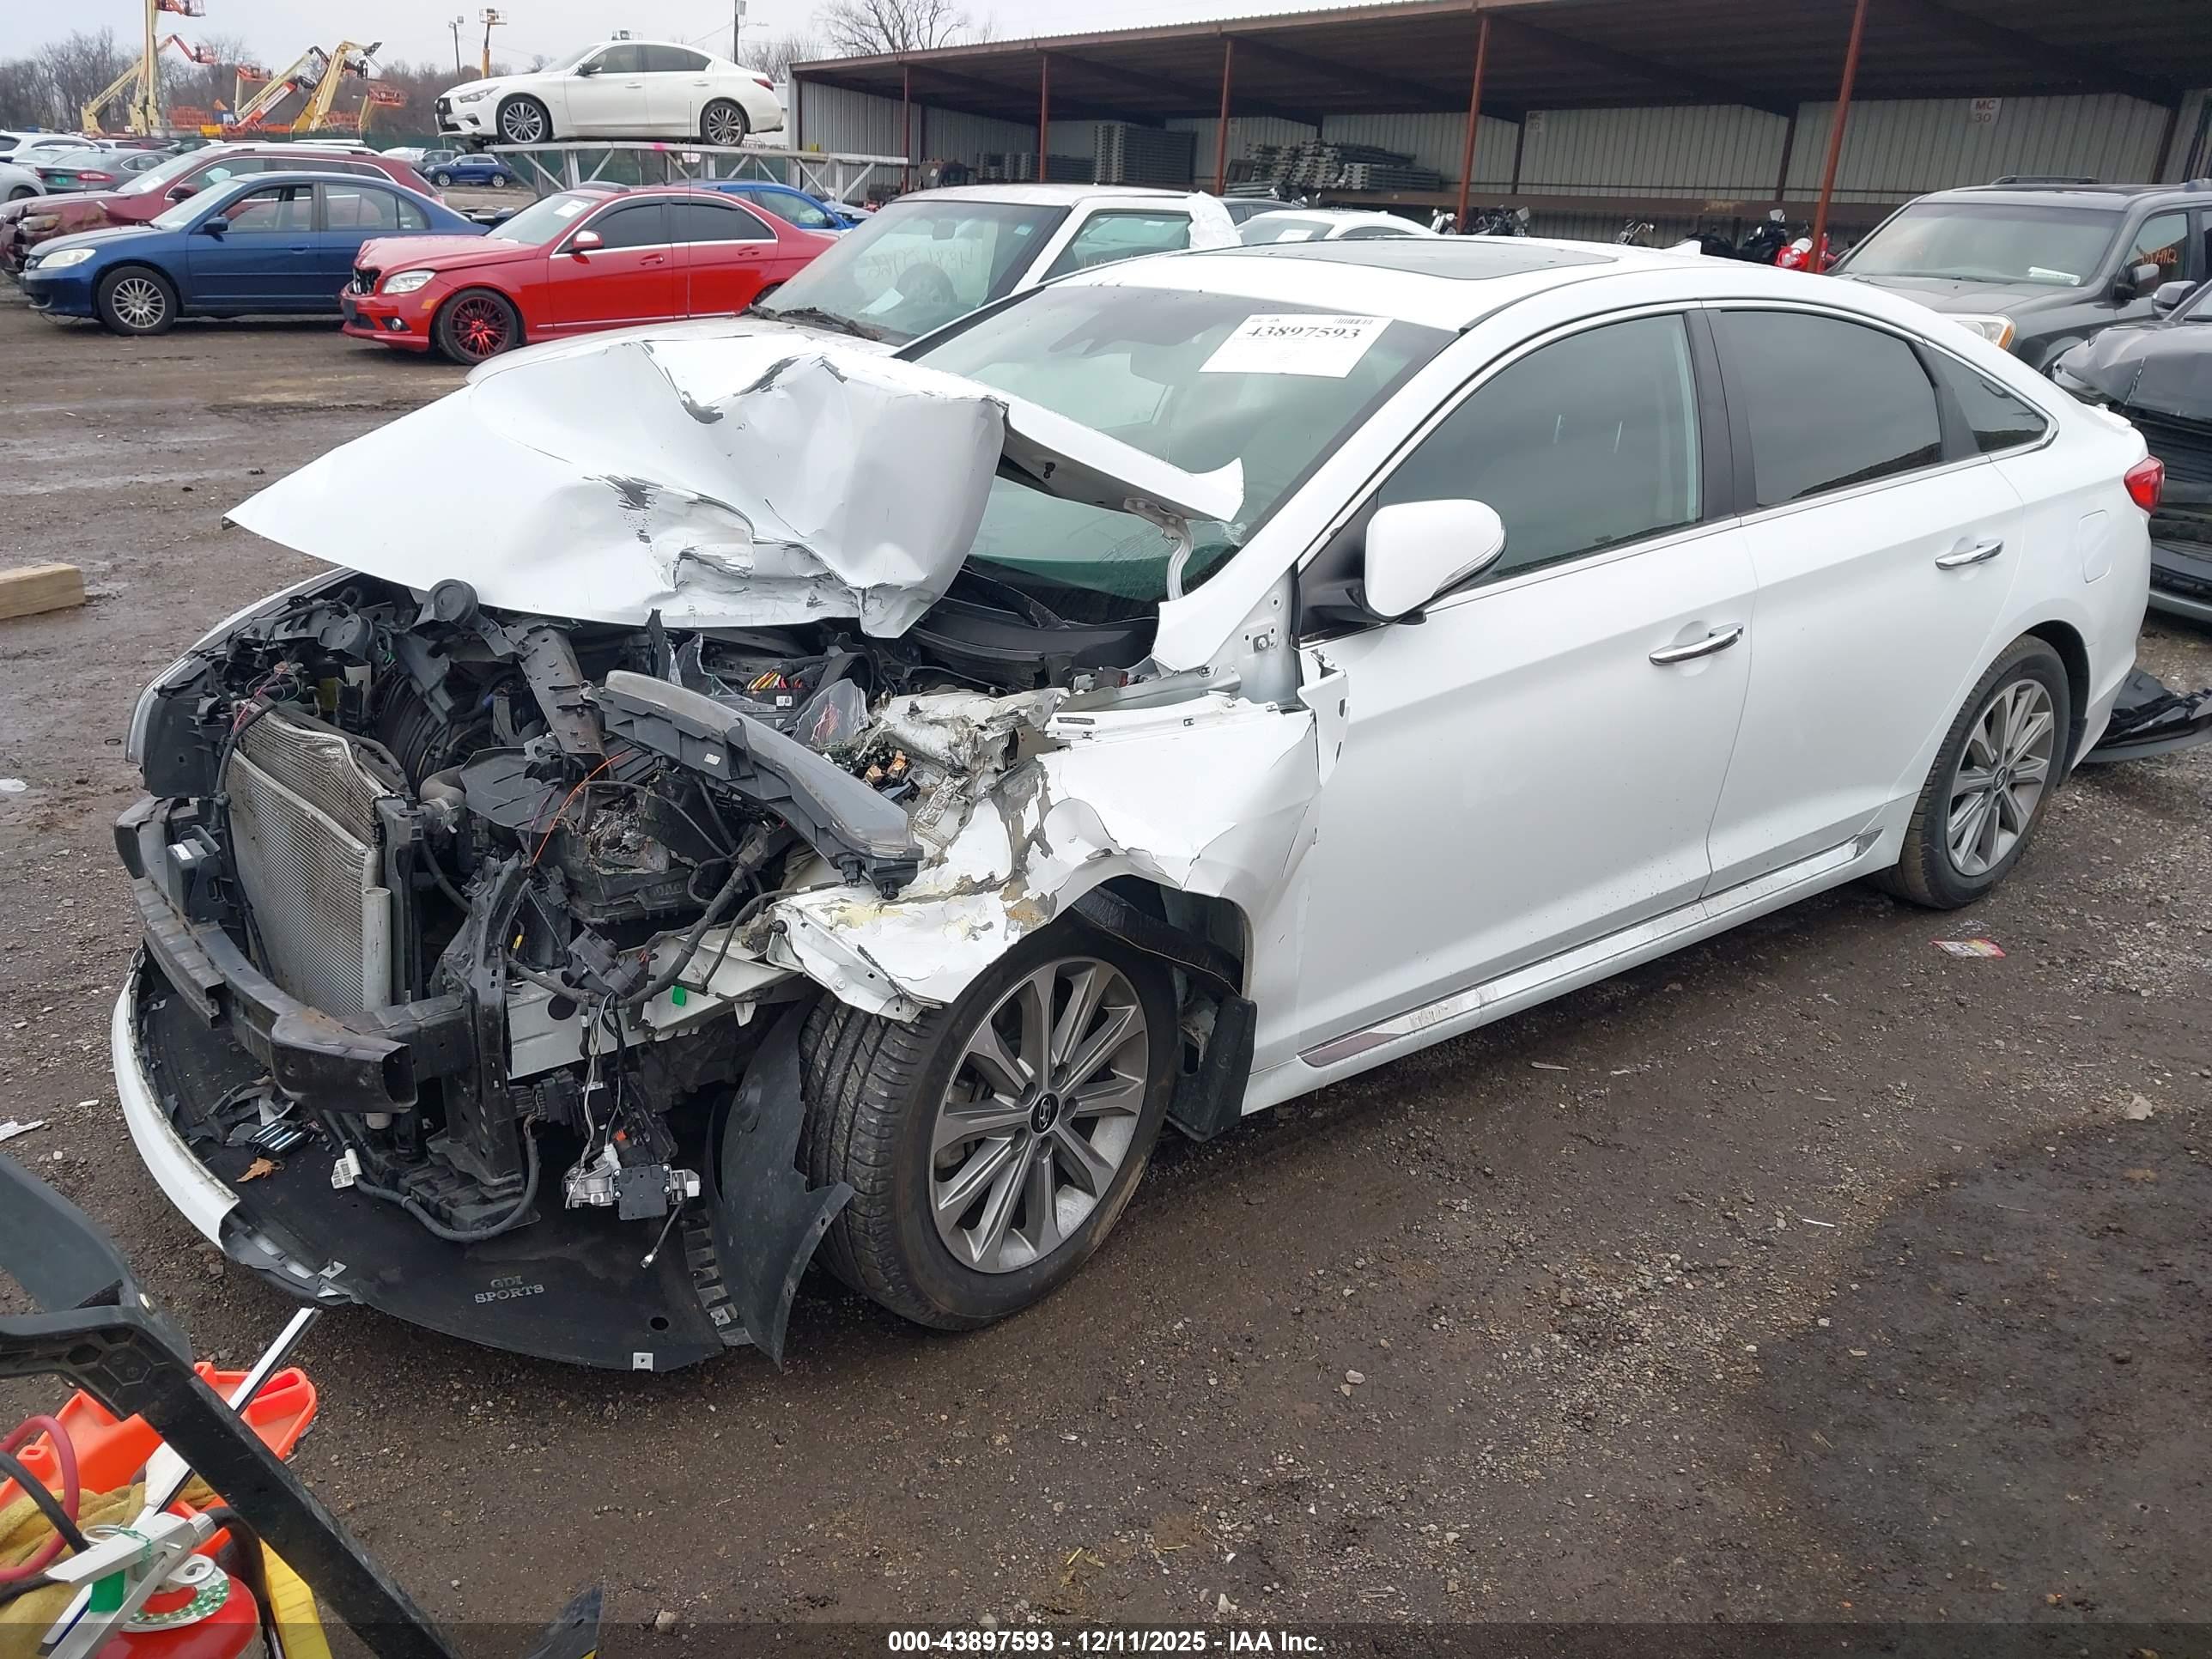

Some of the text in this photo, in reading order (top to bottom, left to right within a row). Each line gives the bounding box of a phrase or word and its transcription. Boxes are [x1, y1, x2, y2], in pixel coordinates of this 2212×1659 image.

[1976, 99, 1996, 111] MC
[1975, 112, 1992, 123] 30
[1246, 325, 1362, 339] 43897593
[490, 1275, 523, 1289] GDI
[474, 1284, 544, 1304] SPORTS
